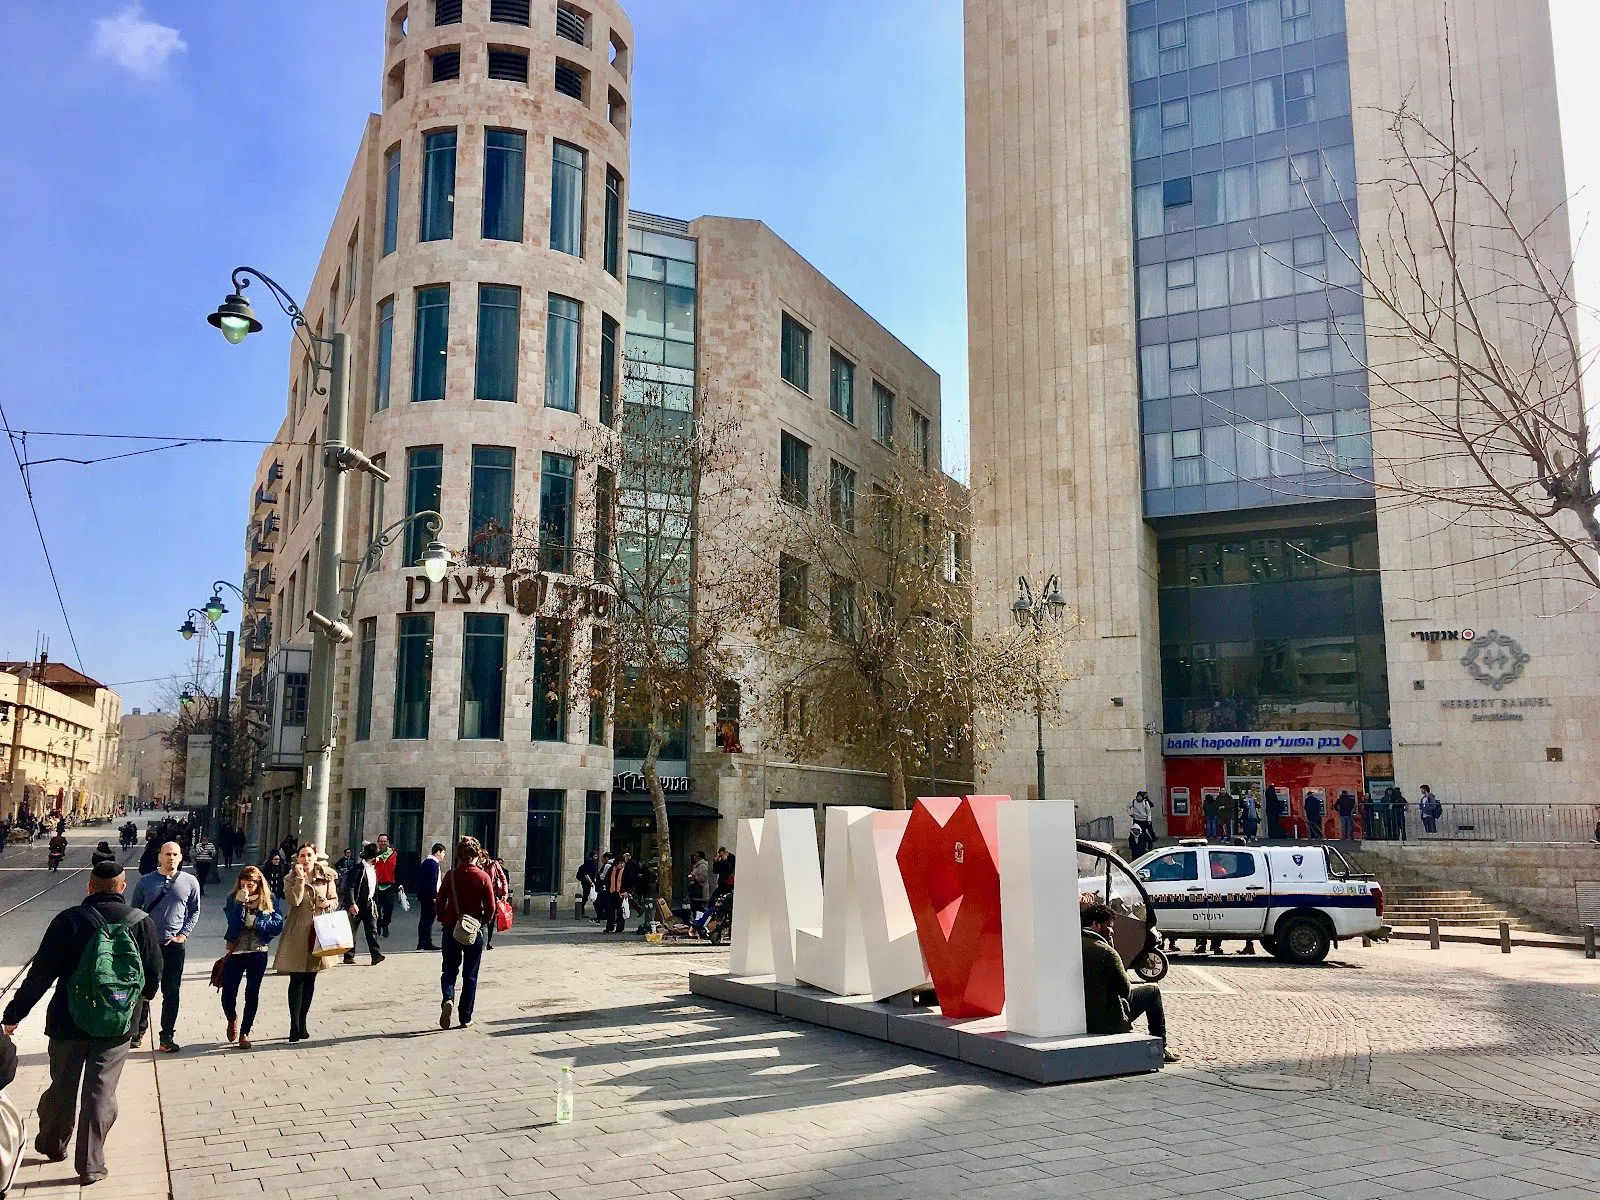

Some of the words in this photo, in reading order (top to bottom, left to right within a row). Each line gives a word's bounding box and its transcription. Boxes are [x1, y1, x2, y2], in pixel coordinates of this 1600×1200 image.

[1410, 630, 1459, 644] אנקורי
[1440, 699, 1495, 709] HERBERT
[1501, 697, 1552, 707] SAMUEL
[1167, 738, 1199, 749] bank
[1201, 735, 1261, 750] hapoalim
[1264, 735, 1314, 747] הפועלים
[1317, 737, 1341, 749] בנק
[1192, 912, 1224, 921] ירושלים
